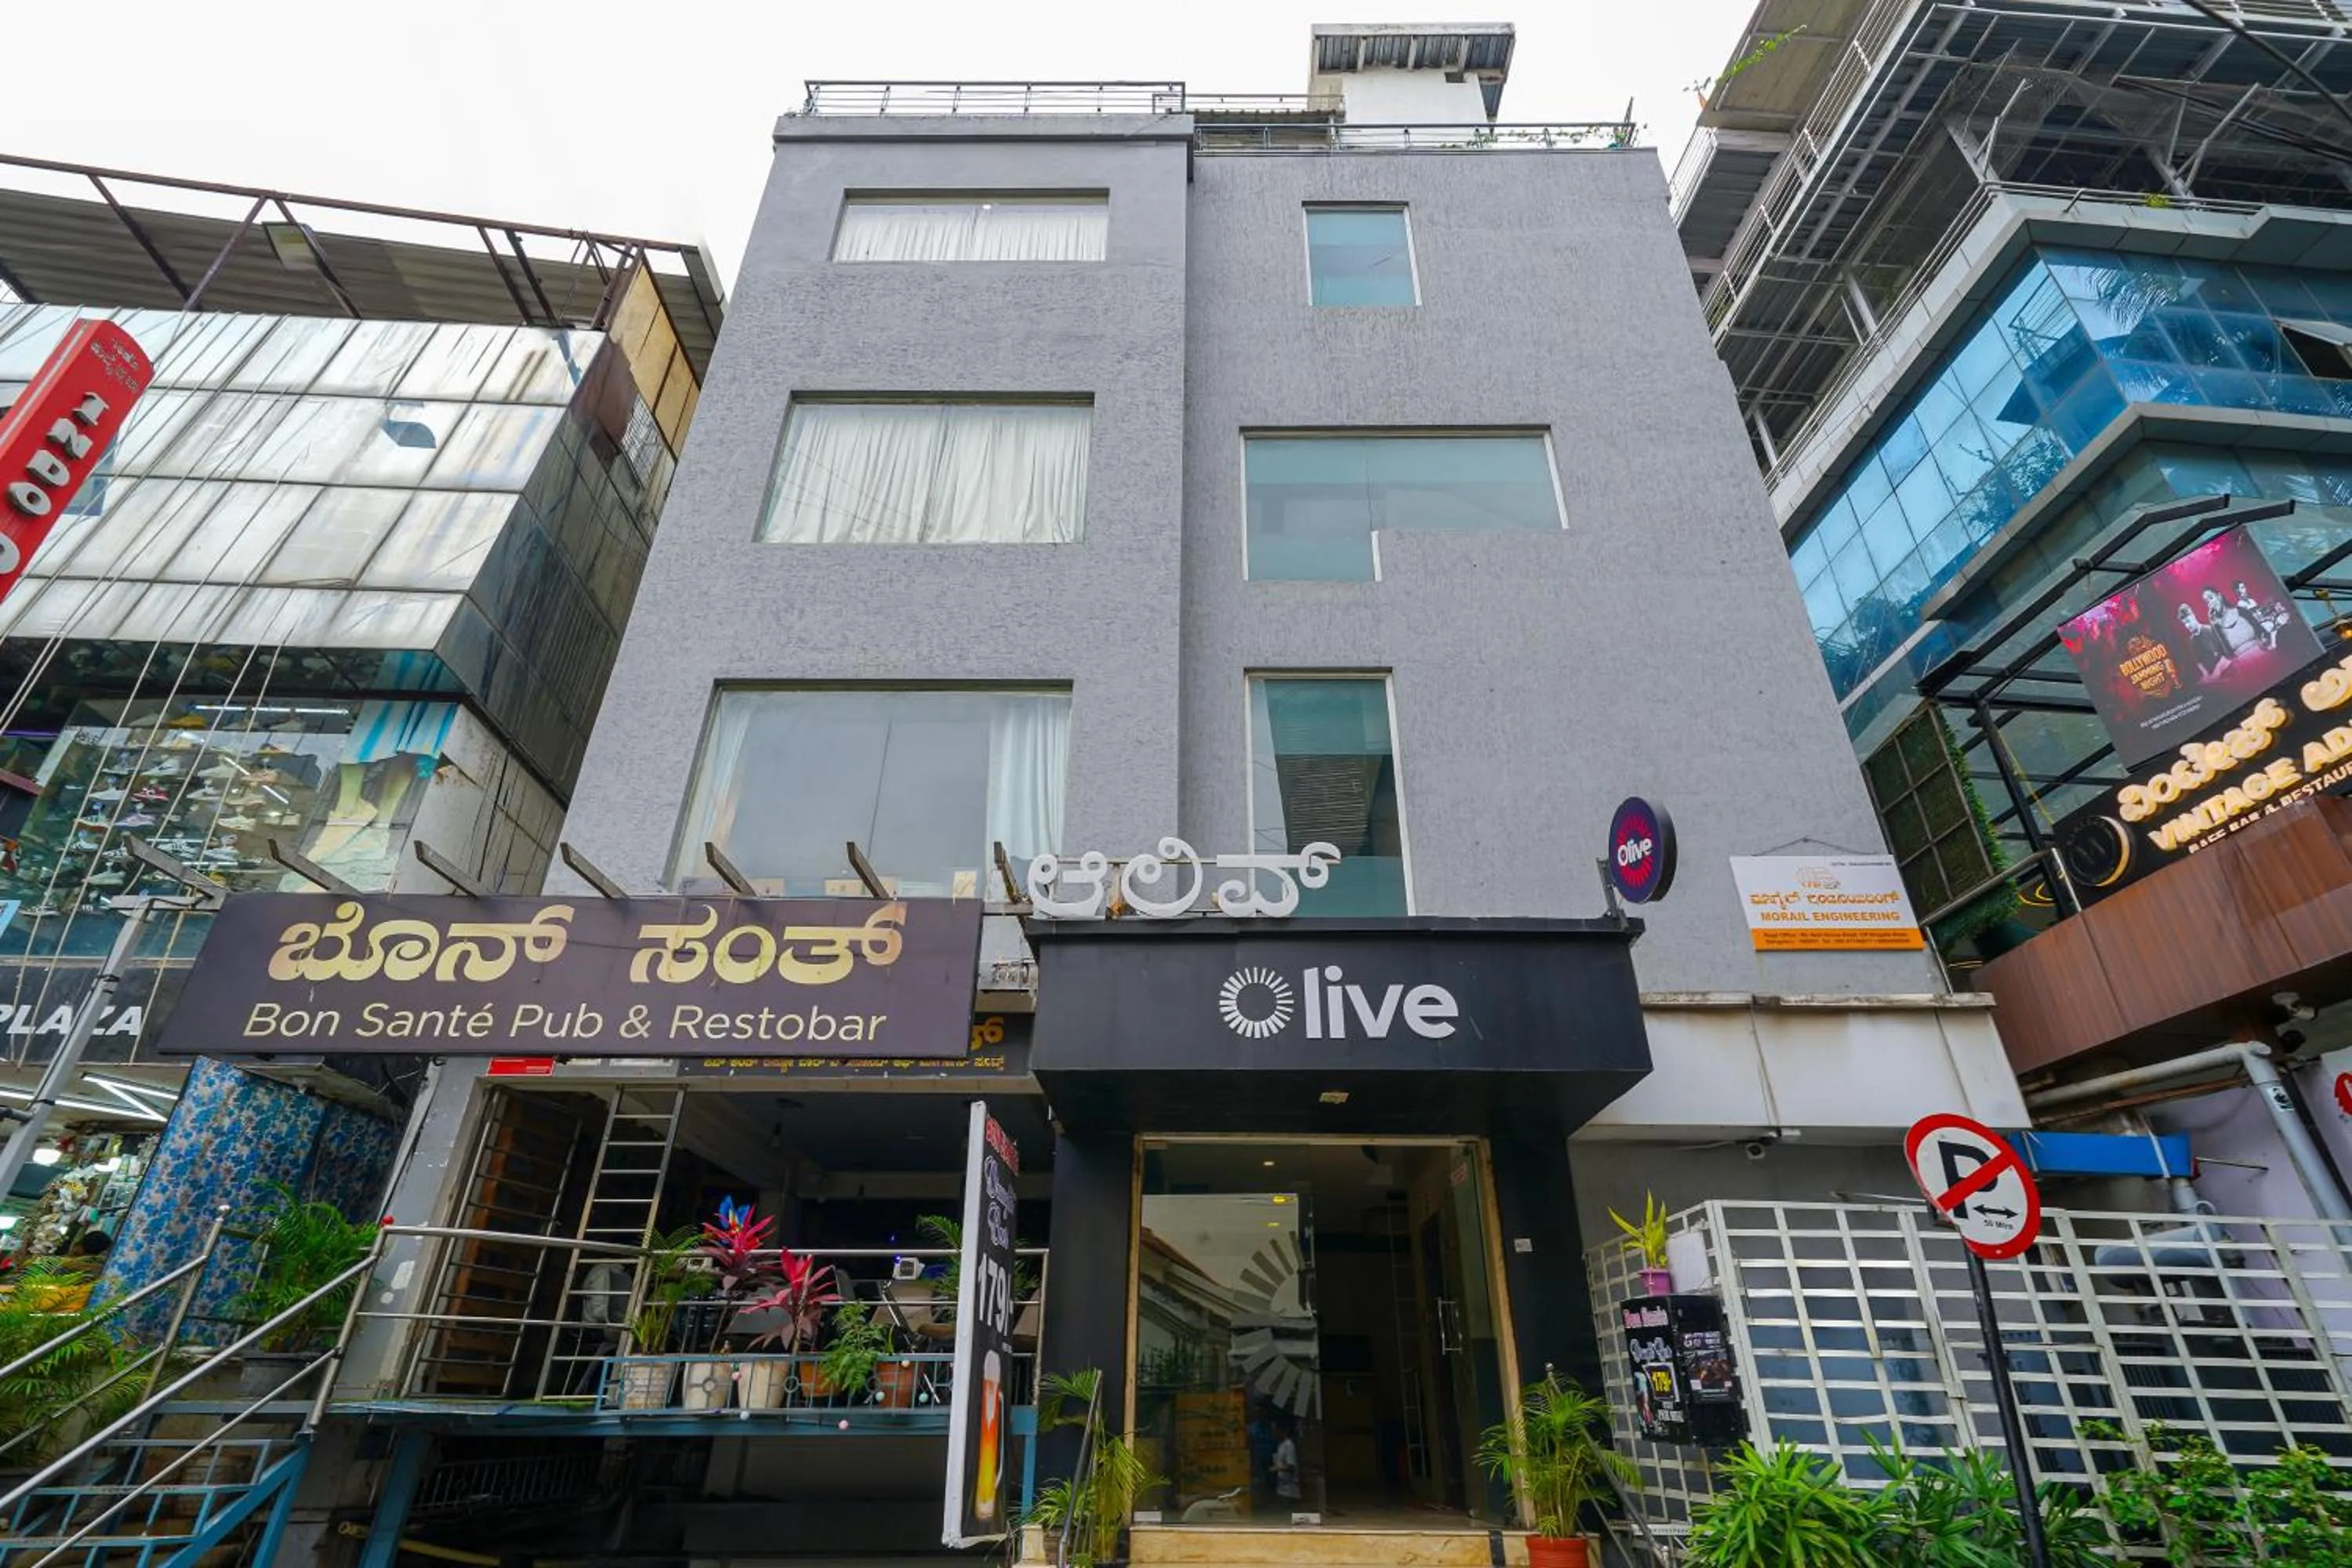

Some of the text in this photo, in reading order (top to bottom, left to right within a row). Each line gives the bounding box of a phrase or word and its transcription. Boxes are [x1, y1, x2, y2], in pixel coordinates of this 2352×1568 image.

[2120, 644, 2167, 677] BOLLYWOOD
[2147, 719, 2352, 852] VINTAGE AD
[1618, 838, 1652, 866] Olive
[1028, 837, 1342, 918] ಆಲಿವ್
[1761, 912, 1900, 921] MORAIL ENGINEERING
[243, 1002, 887, 1041] Bon Santé Pub & Restobar
